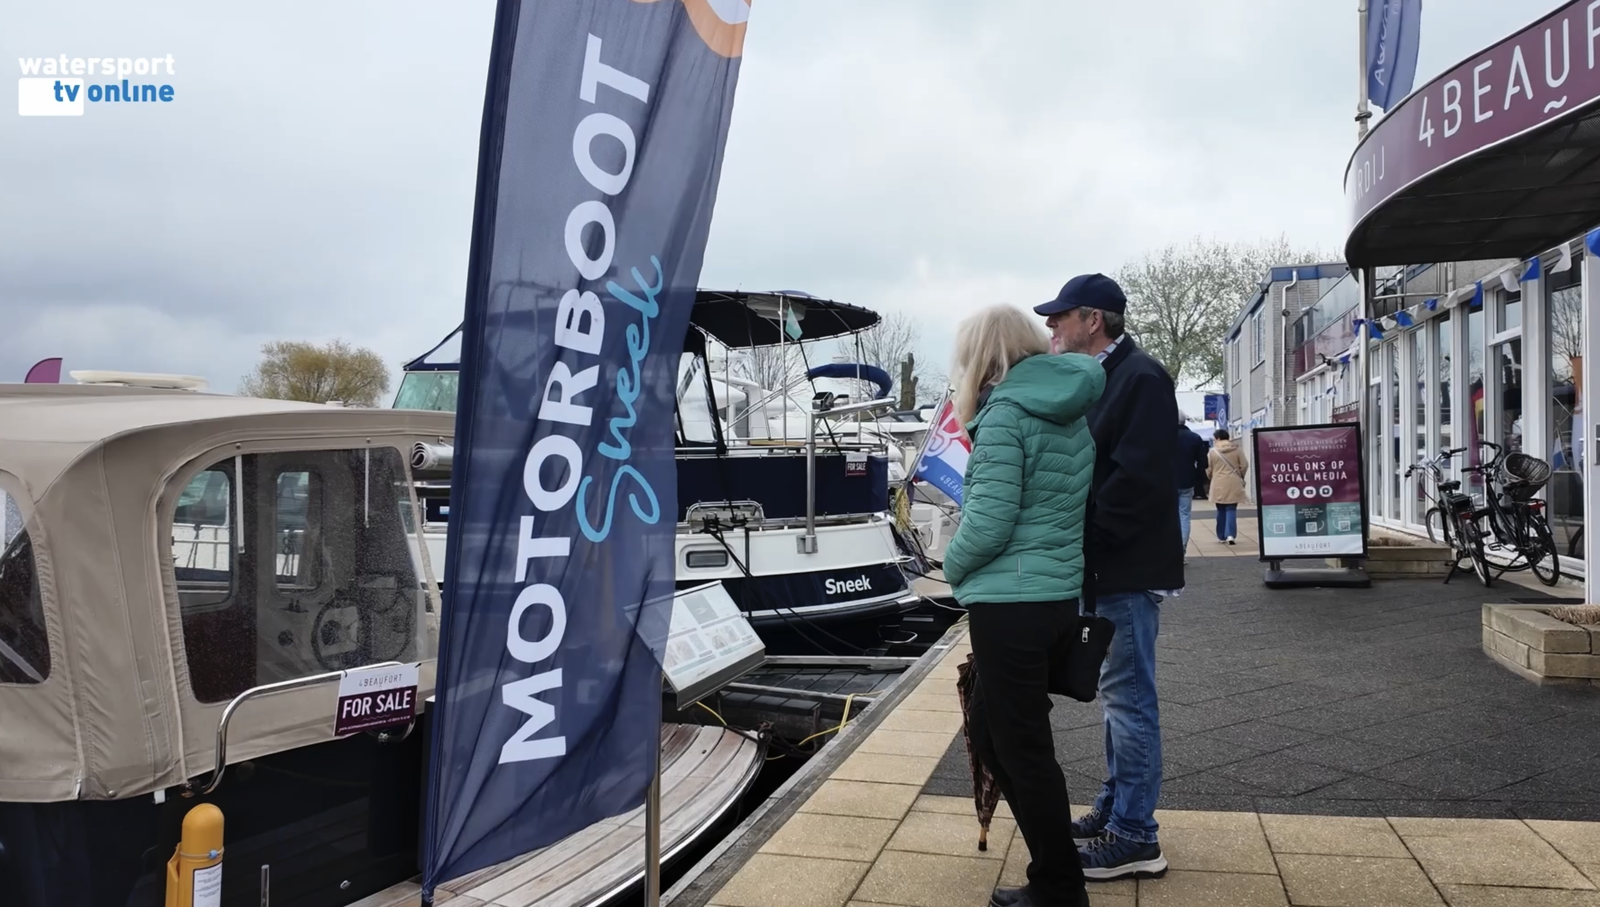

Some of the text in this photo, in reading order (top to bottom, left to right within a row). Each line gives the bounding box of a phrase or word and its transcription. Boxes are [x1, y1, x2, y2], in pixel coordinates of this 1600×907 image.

[1354, 145, 1385, 202] RDIJ
[498, 32, 650, 764] MOTORBOOT
[575, 254, 663, 543] Sneek
[847, 462, 866, 471] FOR SALE
[1272, 460, 1345, 472] VOLG ONS OP
[1271, 471, 1347, 483] SOCIAL MEDIA
[825, 574, 872, 595] Sneek
[358, 673, 403, 688] 4BEAUFORT
[342, 689, 412, 719] FOR SALE
